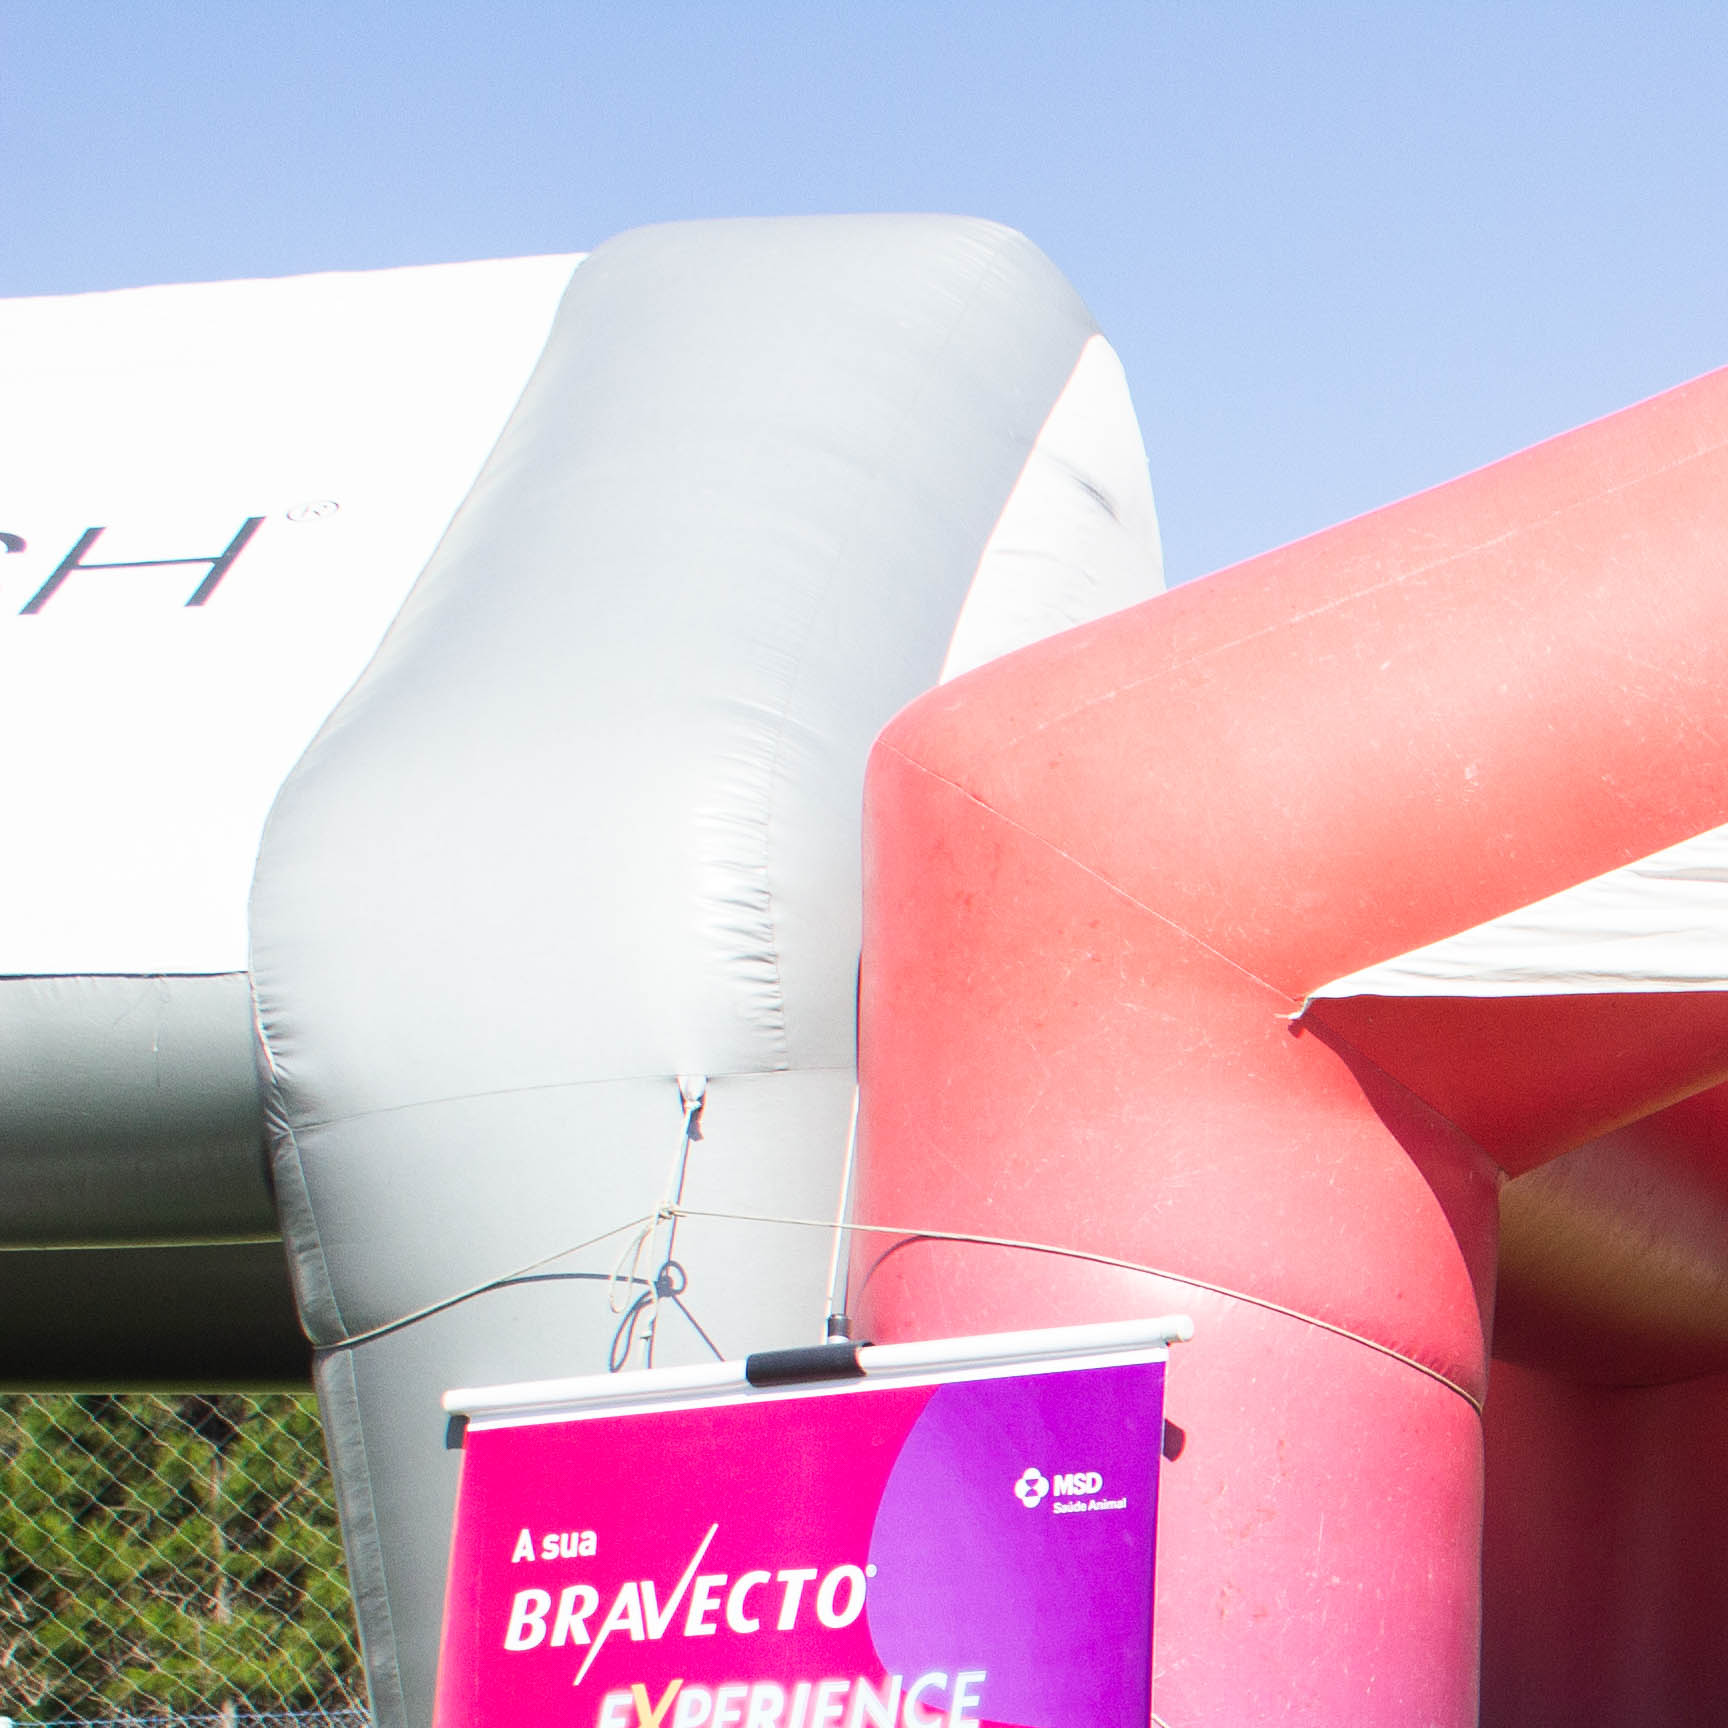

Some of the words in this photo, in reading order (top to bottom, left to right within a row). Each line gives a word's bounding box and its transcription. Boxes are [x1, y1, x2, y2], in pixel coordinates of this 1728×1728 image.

[0, 516, 266, 616] H
[1053, 1472, 1103, 1497] MSD
[511, 1528, 535, 1562] A
[542, 1531, 597, 1560] sua
[504, 1523, 869, 1686] BRAVECTO
